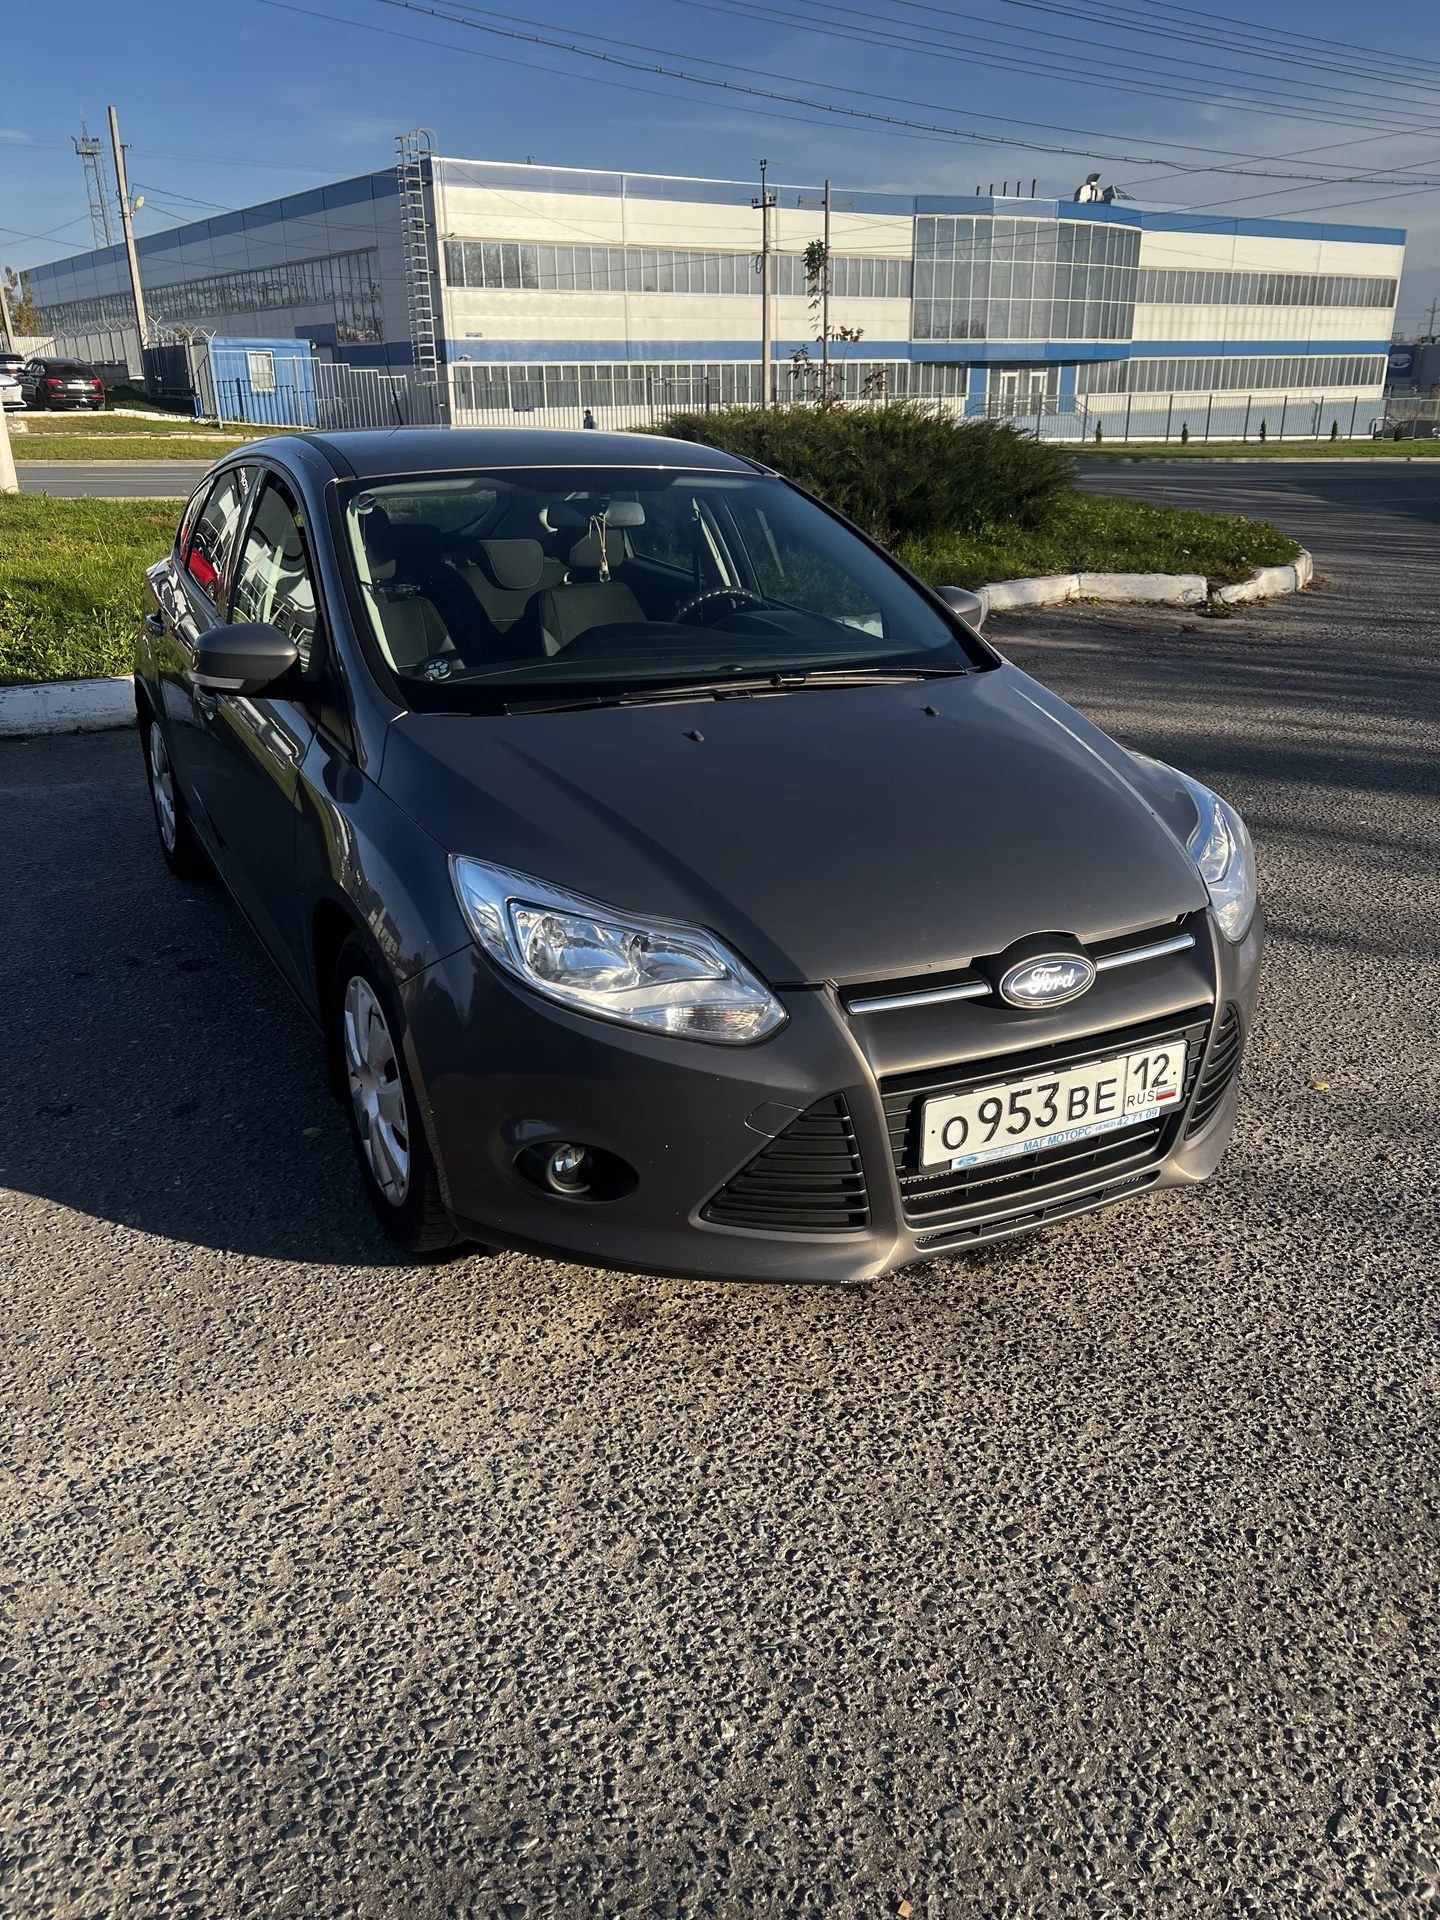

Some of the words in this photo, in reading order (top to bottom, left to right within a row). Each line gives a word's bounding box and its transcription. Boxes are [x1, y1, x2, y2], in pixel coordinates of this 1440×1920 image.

[1028, 965, 1076, 995] Ford
[1133, 1053, 1170, 1091] 12
[1126, 1090, 1155, 1108] RUS
[1023, 1137, 1046, 1152] МАГ
[1047, 1126, 1092, 1146] МОТОРС
[1116, 1116, 1129, 1126] 42
[1132, 1112, 1143, 1123] 71
[1145, 1108, 1158, 1119] 09
